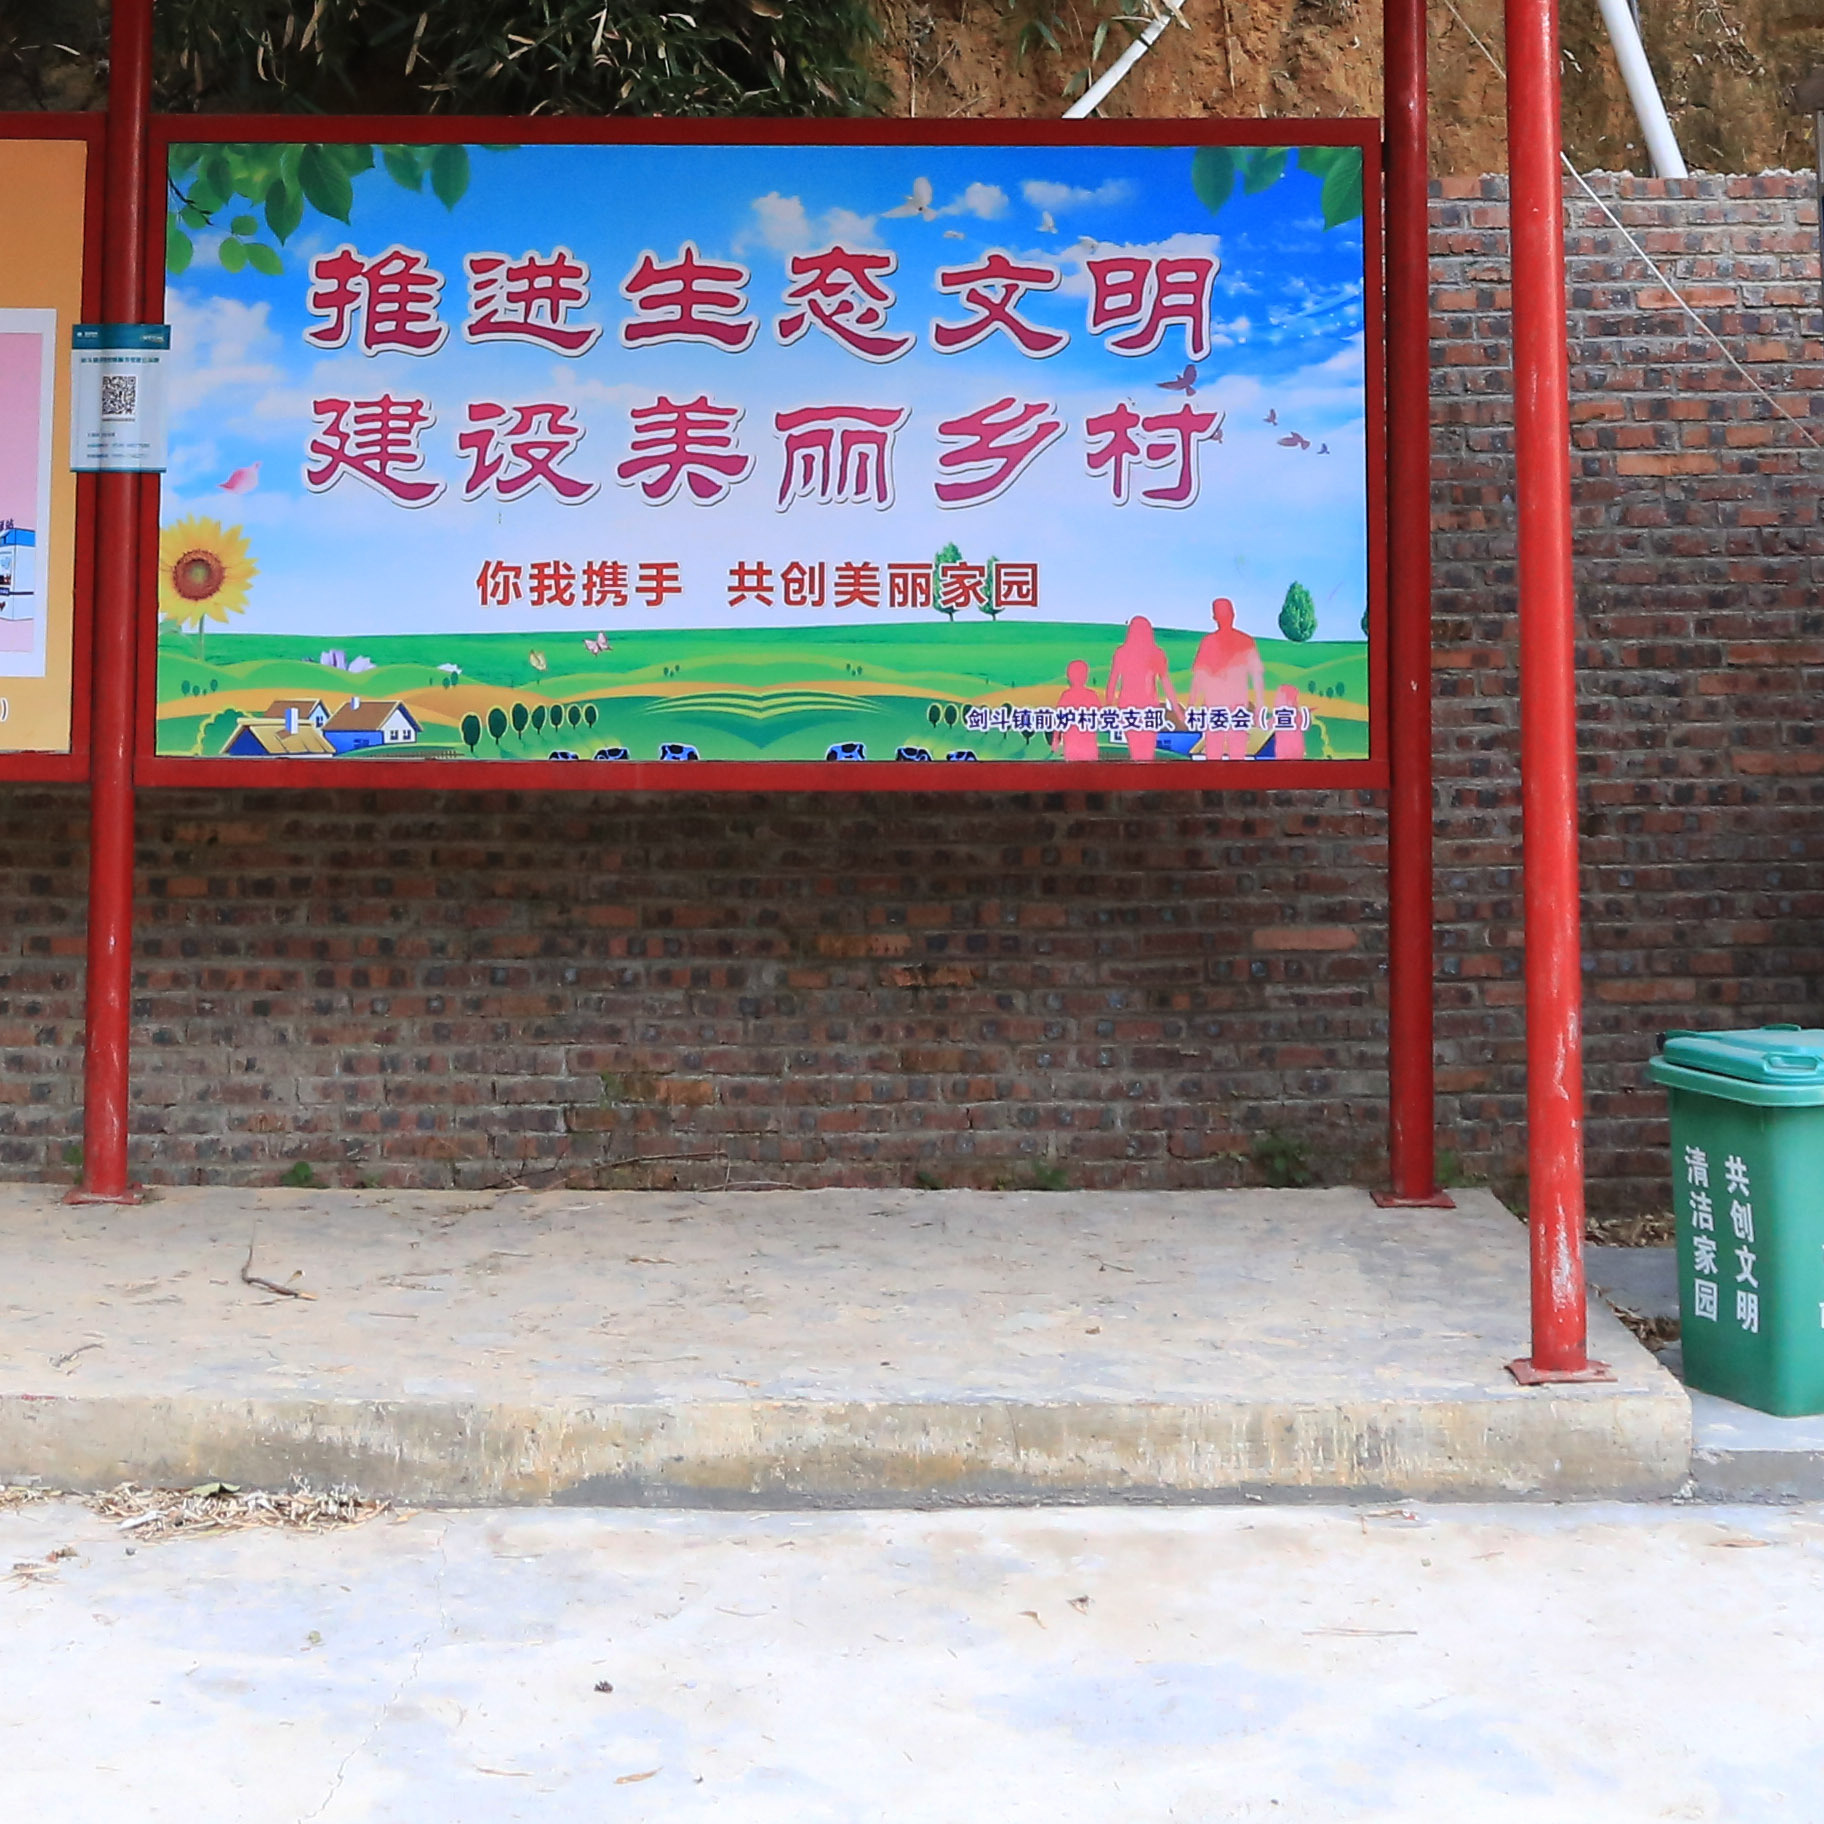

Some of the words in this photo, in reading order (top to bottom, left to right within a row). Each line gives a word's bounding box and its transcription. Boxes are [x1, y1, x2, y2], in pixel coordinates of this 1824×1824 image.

[305, 243, 1218, 359] 推进生态文明
[306, 393, 1220, 508] 建设美丽乡村
[476, 560, 683, 607] 你我携手
[727, 560, 1040, 608] 共创美丽家园
[1684, 1145, 1718, 1323] 清洁家园
[1724, 1155, 1759, 1334] 共创文明
